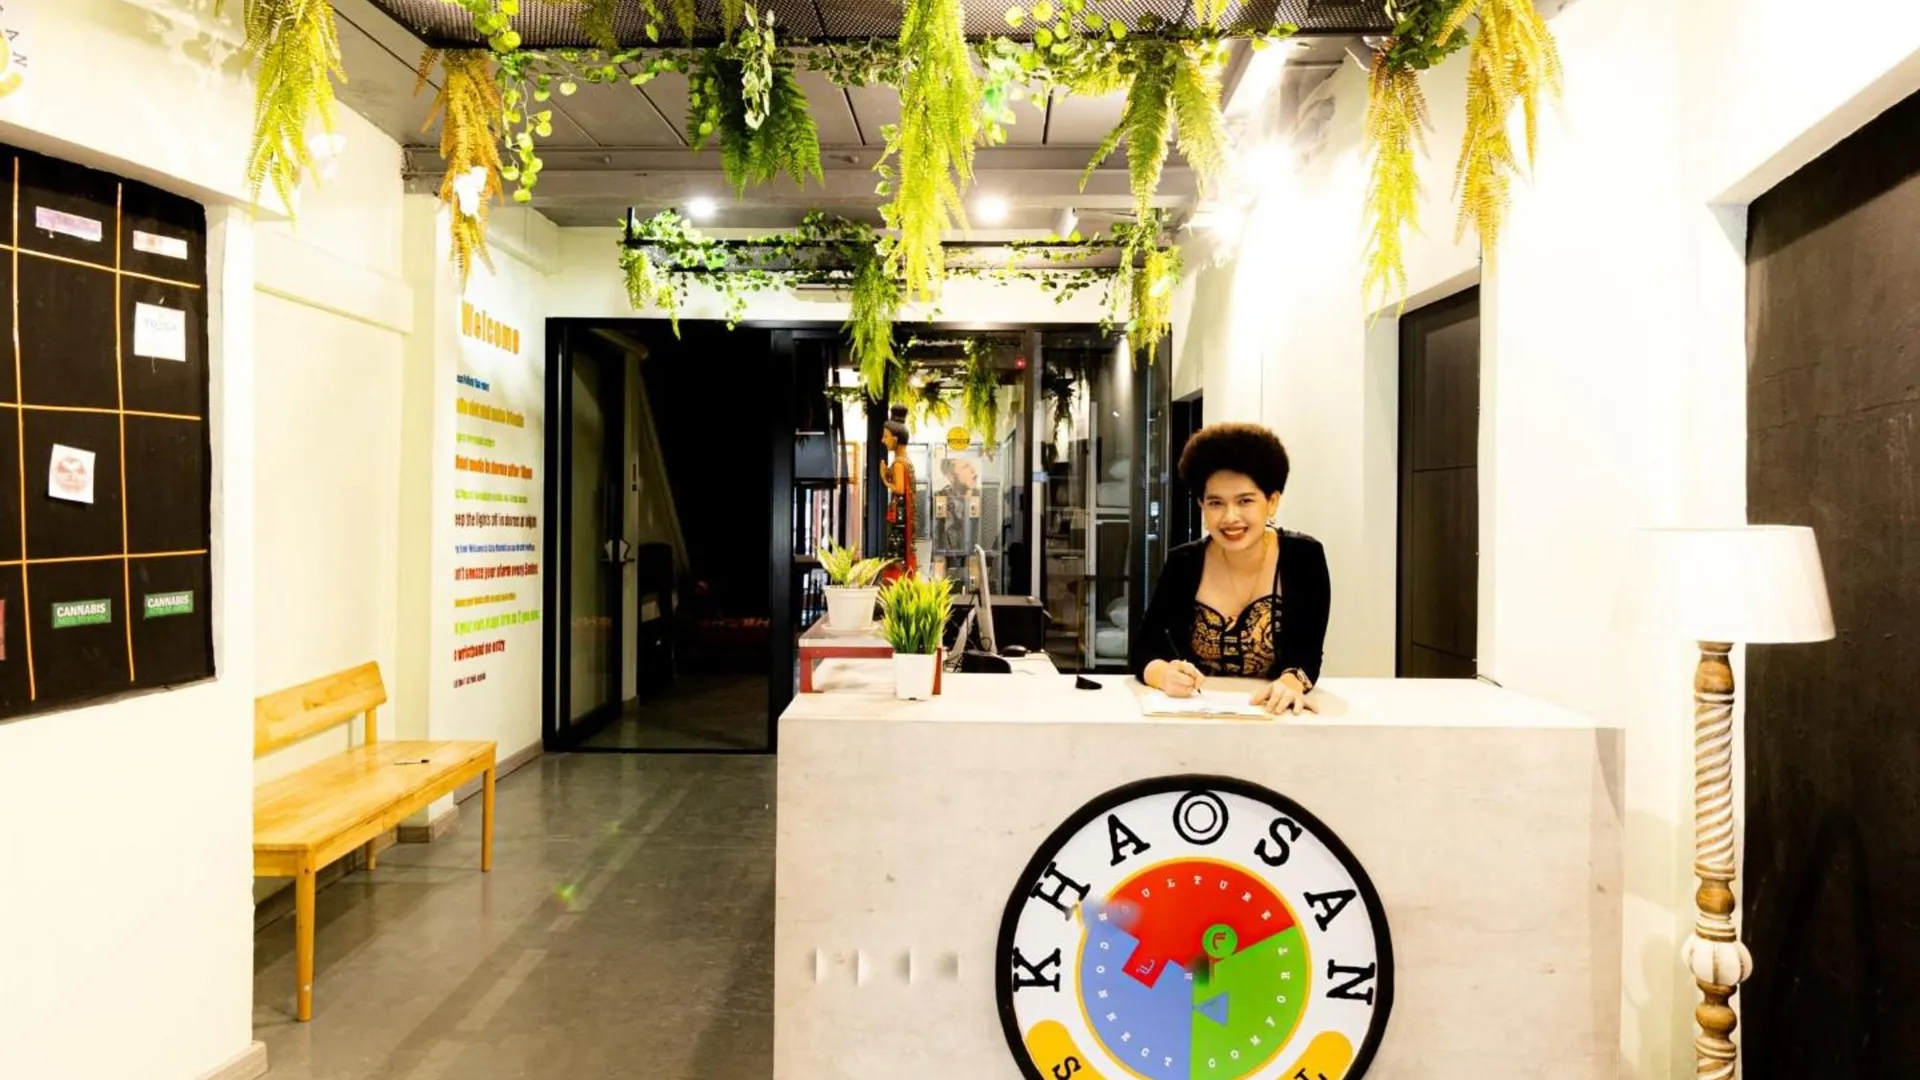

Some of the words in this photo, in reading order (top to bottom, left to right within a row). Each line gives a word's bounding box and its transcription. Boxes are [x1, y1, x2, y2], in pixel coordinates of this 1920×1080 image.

[461, 300, 520, 355] Welcome
[466, 513, 475, 526] the
[476, 512, 490, 528] lights
[147, 595, 189, 608] CANNABIS
[56, 603, 106, 617] CANNABIS
[1012, 789, 1377, 1006] KHAOSAN
